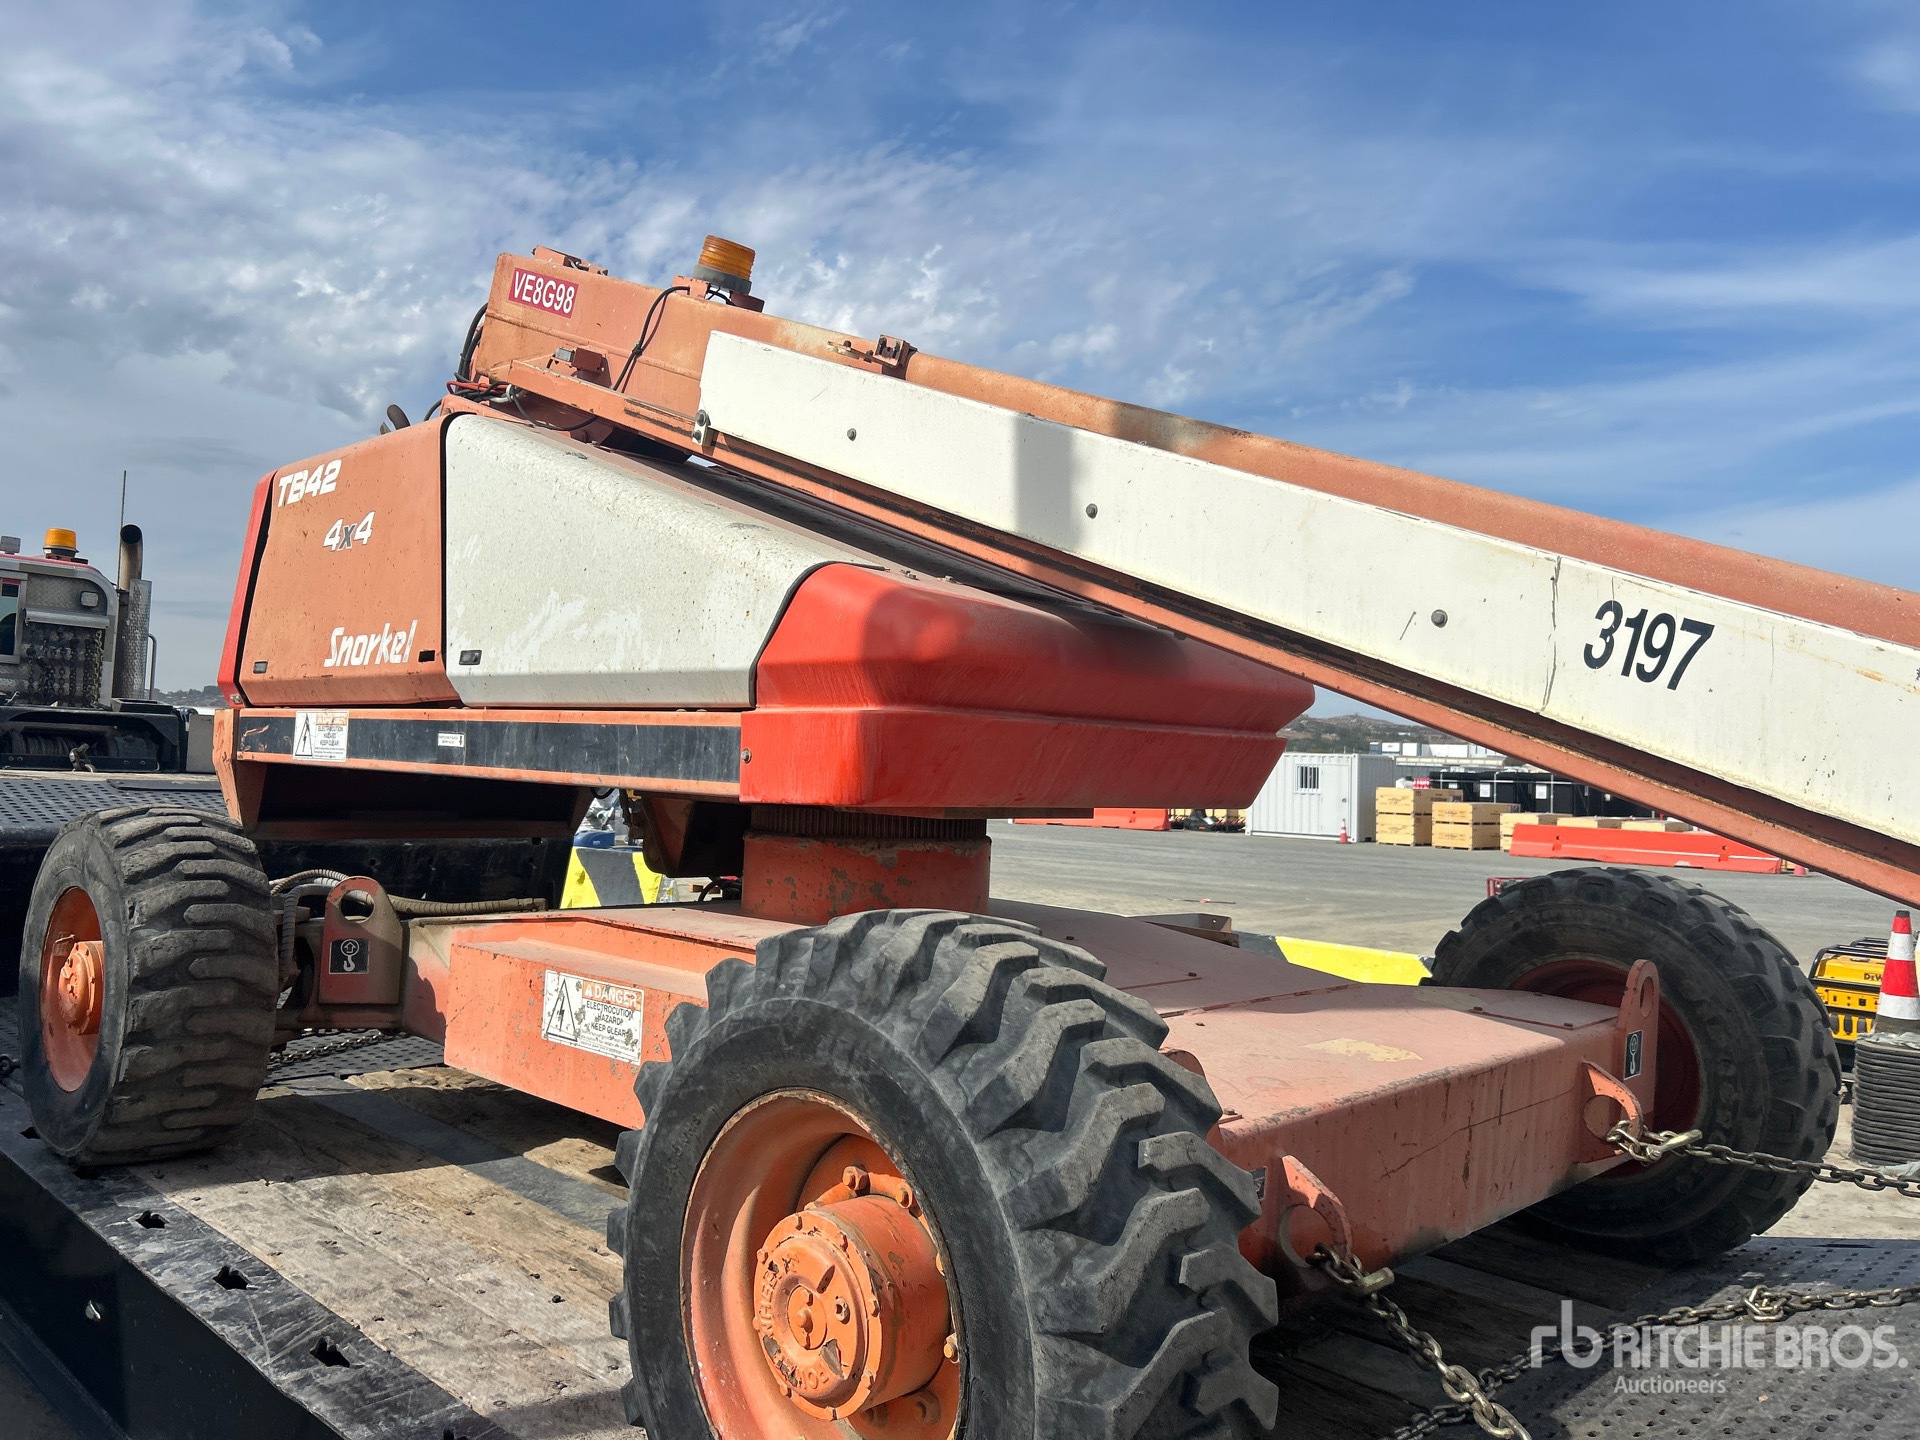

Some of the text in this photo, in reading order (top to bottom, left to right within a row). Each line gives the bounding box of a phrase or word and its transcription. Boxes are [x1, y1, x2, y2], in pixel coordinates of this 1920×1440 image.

[513, 270, 575, 314] VE8G98
[277, 459, 342, 508] TB42
[322, 511, 375, 551] 4x4
[323, 619, 418, 668] Snorkel
[1583, 600, 1715, 691] 3197
[586, 1000, 634, 1019] ELECTROCUTION
[595, 984, 637, 1007] DANGER
[591, 1022, 606, 1032] KEEP
[606, 1025, 626, 1037] CLEAR
